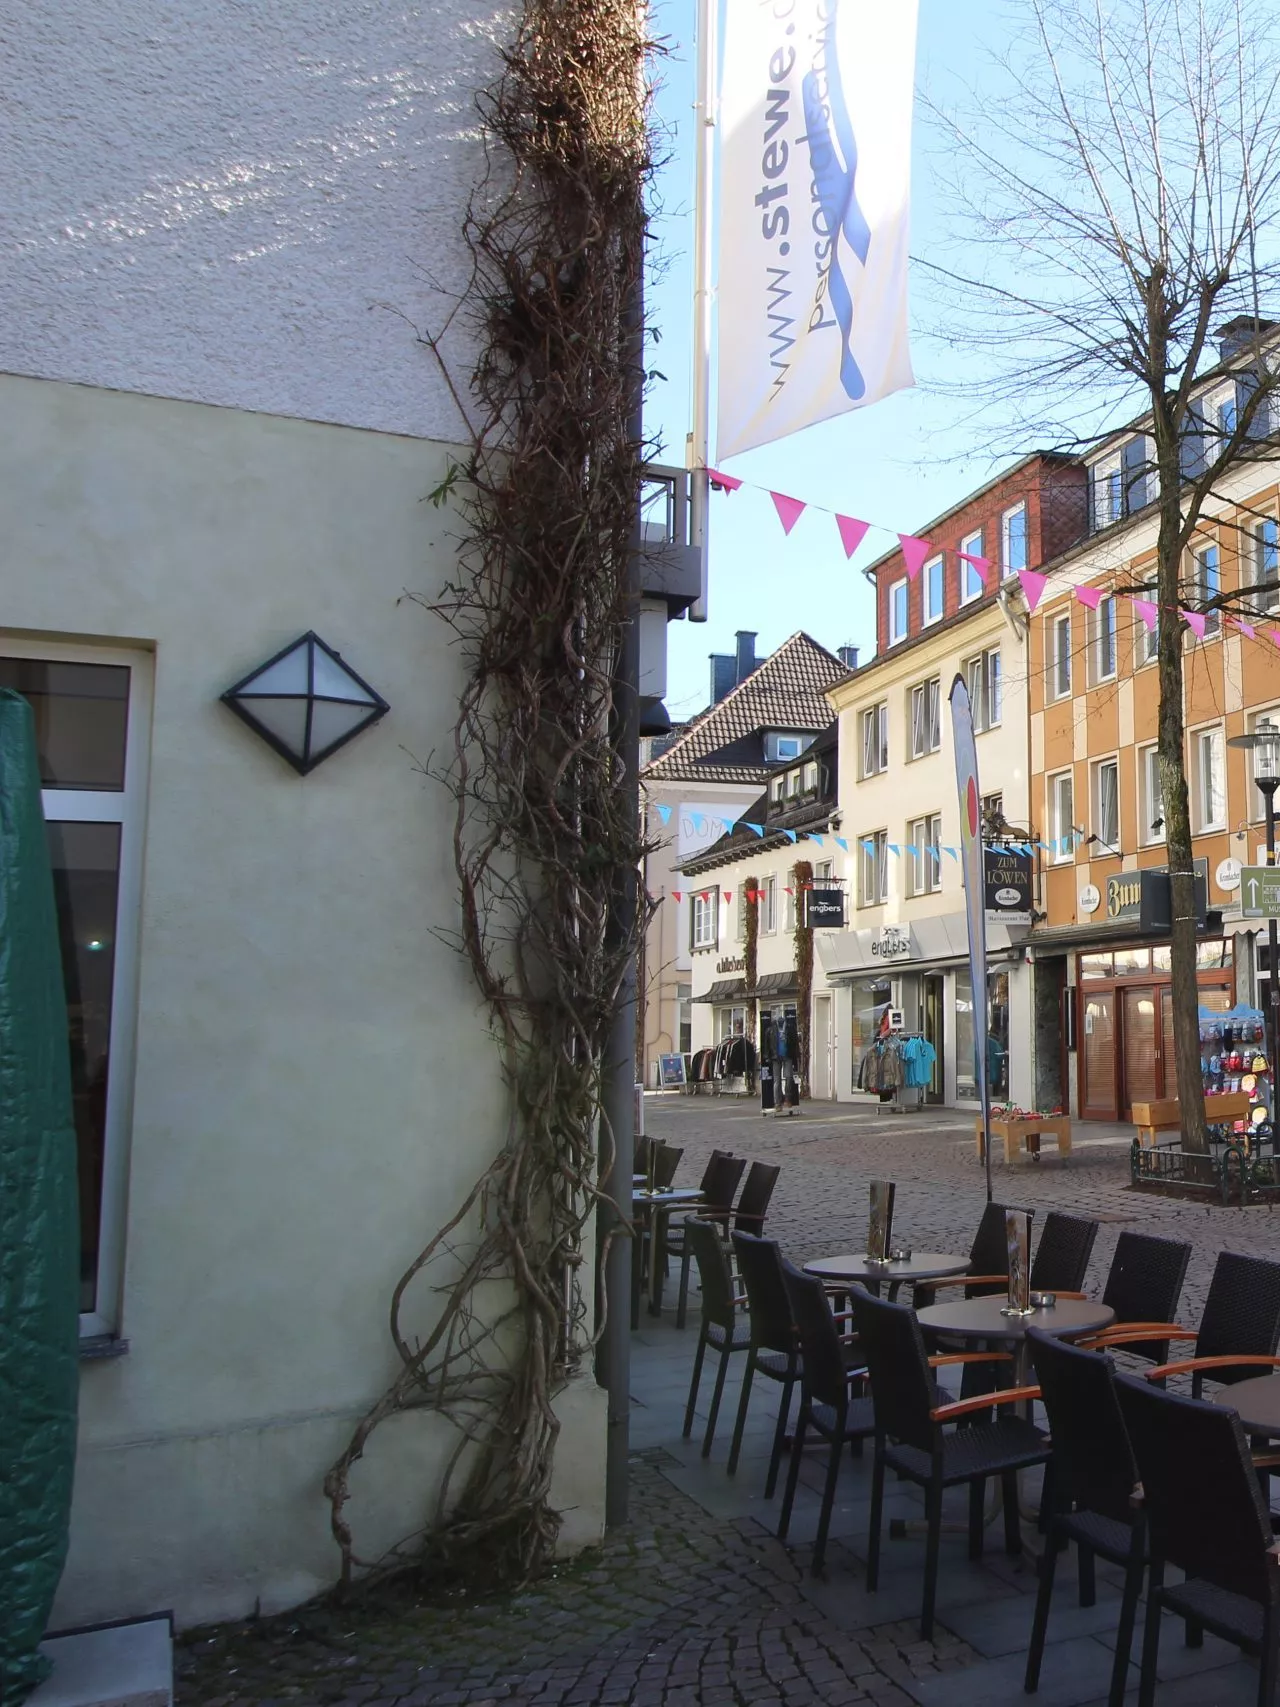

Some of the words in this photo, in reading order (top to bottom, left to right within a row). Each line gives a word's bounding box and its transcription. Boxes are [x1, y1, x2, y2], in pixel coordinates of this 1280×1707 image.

[997, 856, 1017, 868] ZUM
[987, 869, 1028, 884] LÖWEN
[809, 904, 841, 913] engbers
[871, 936, 908, 958] engbers
